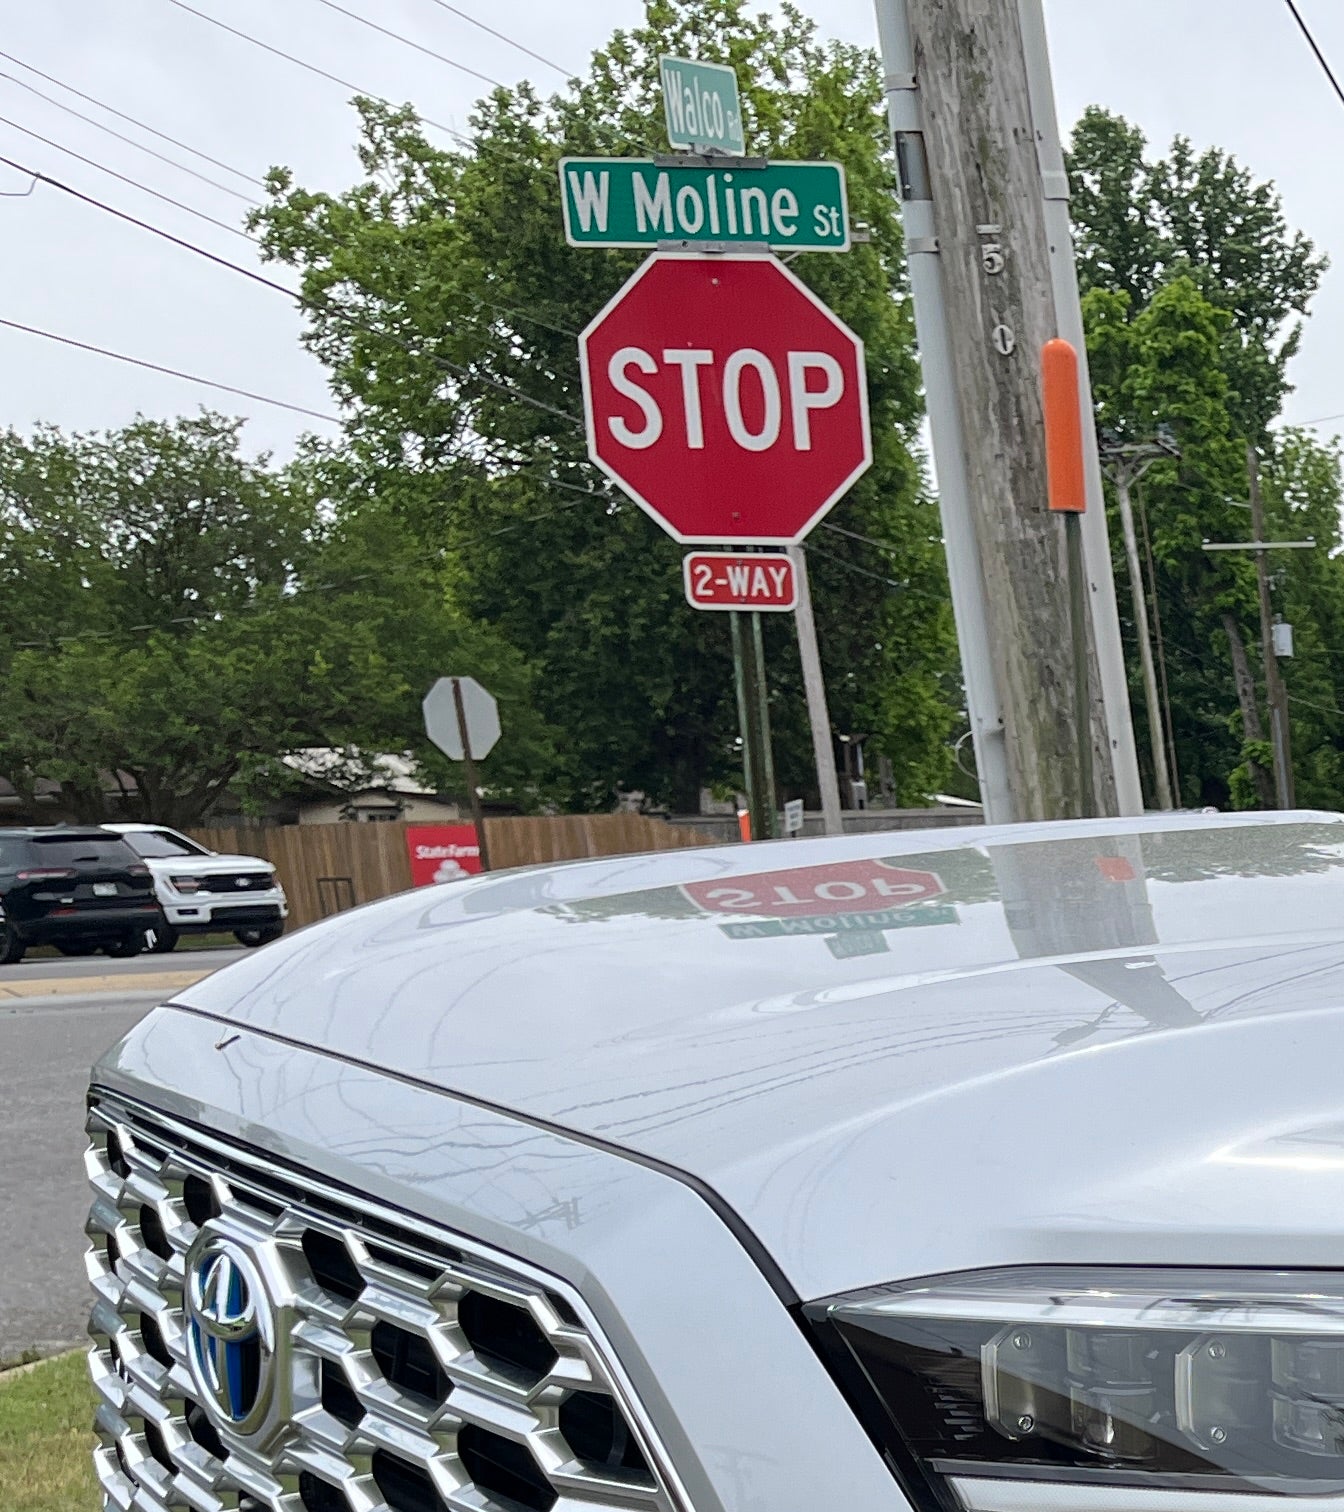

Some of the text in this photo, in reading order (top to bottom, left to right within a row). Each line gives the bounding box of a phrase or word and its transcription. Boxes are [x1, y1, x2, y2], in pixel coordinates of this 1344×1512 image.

[664, 69, 725, 140] Walco
[566, 170, 842, 238] W Moline St
[606, 345, 845, 453] STOP
[692, 562, 789, 599] 2-WAY
